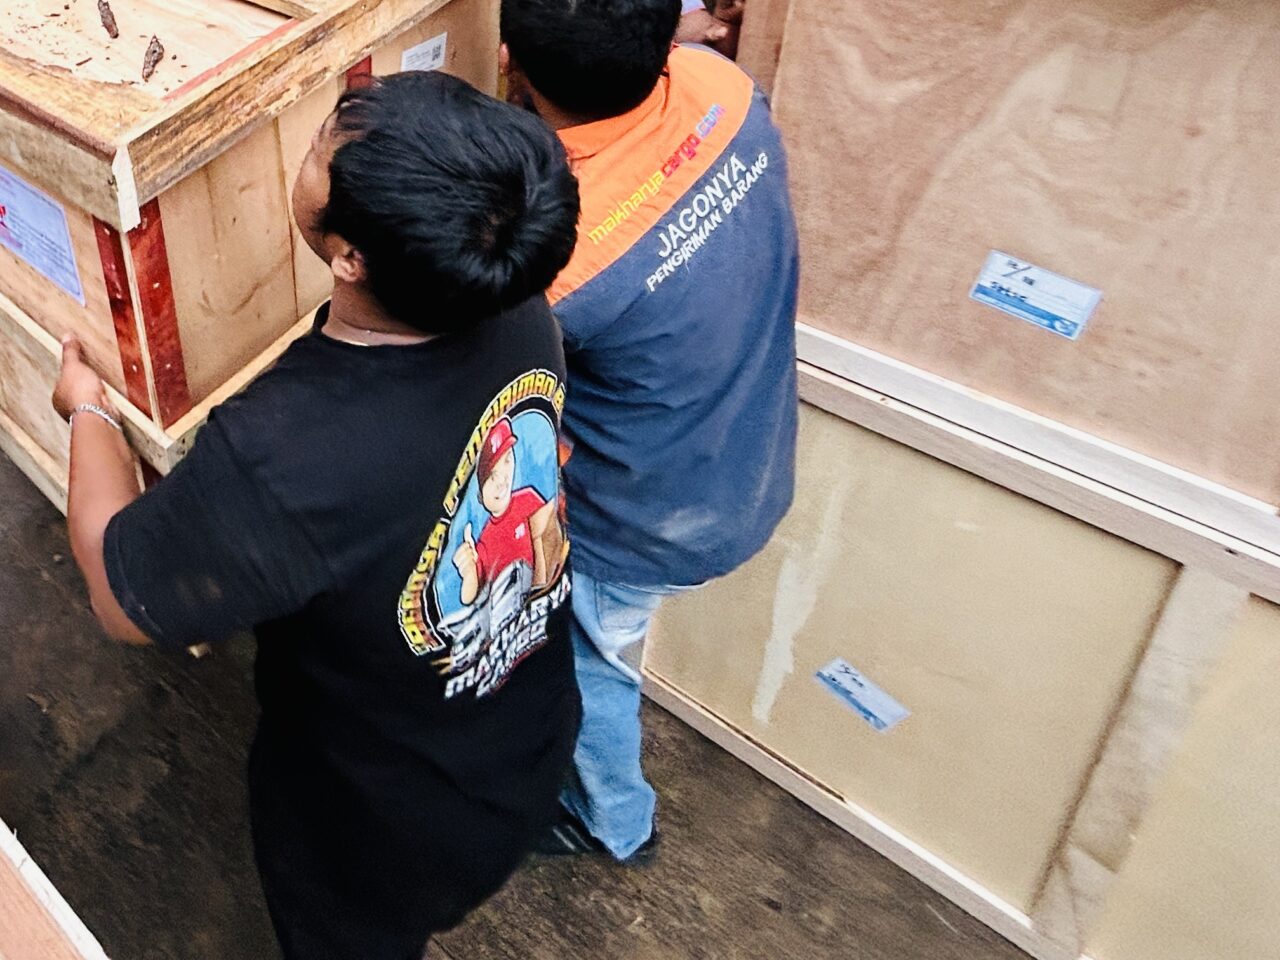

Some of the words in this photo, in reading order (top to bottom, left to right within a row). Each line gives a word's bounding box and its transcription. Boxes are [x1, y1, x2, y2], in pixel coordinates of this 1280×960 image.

[646, 210, 723, 292] PENGIRIMAN
[721, 152, 769, 214] BARANG
[657, 152, 747, 258] JAGONYA
[443, 368, 557, 517] PENGIRIMAN
